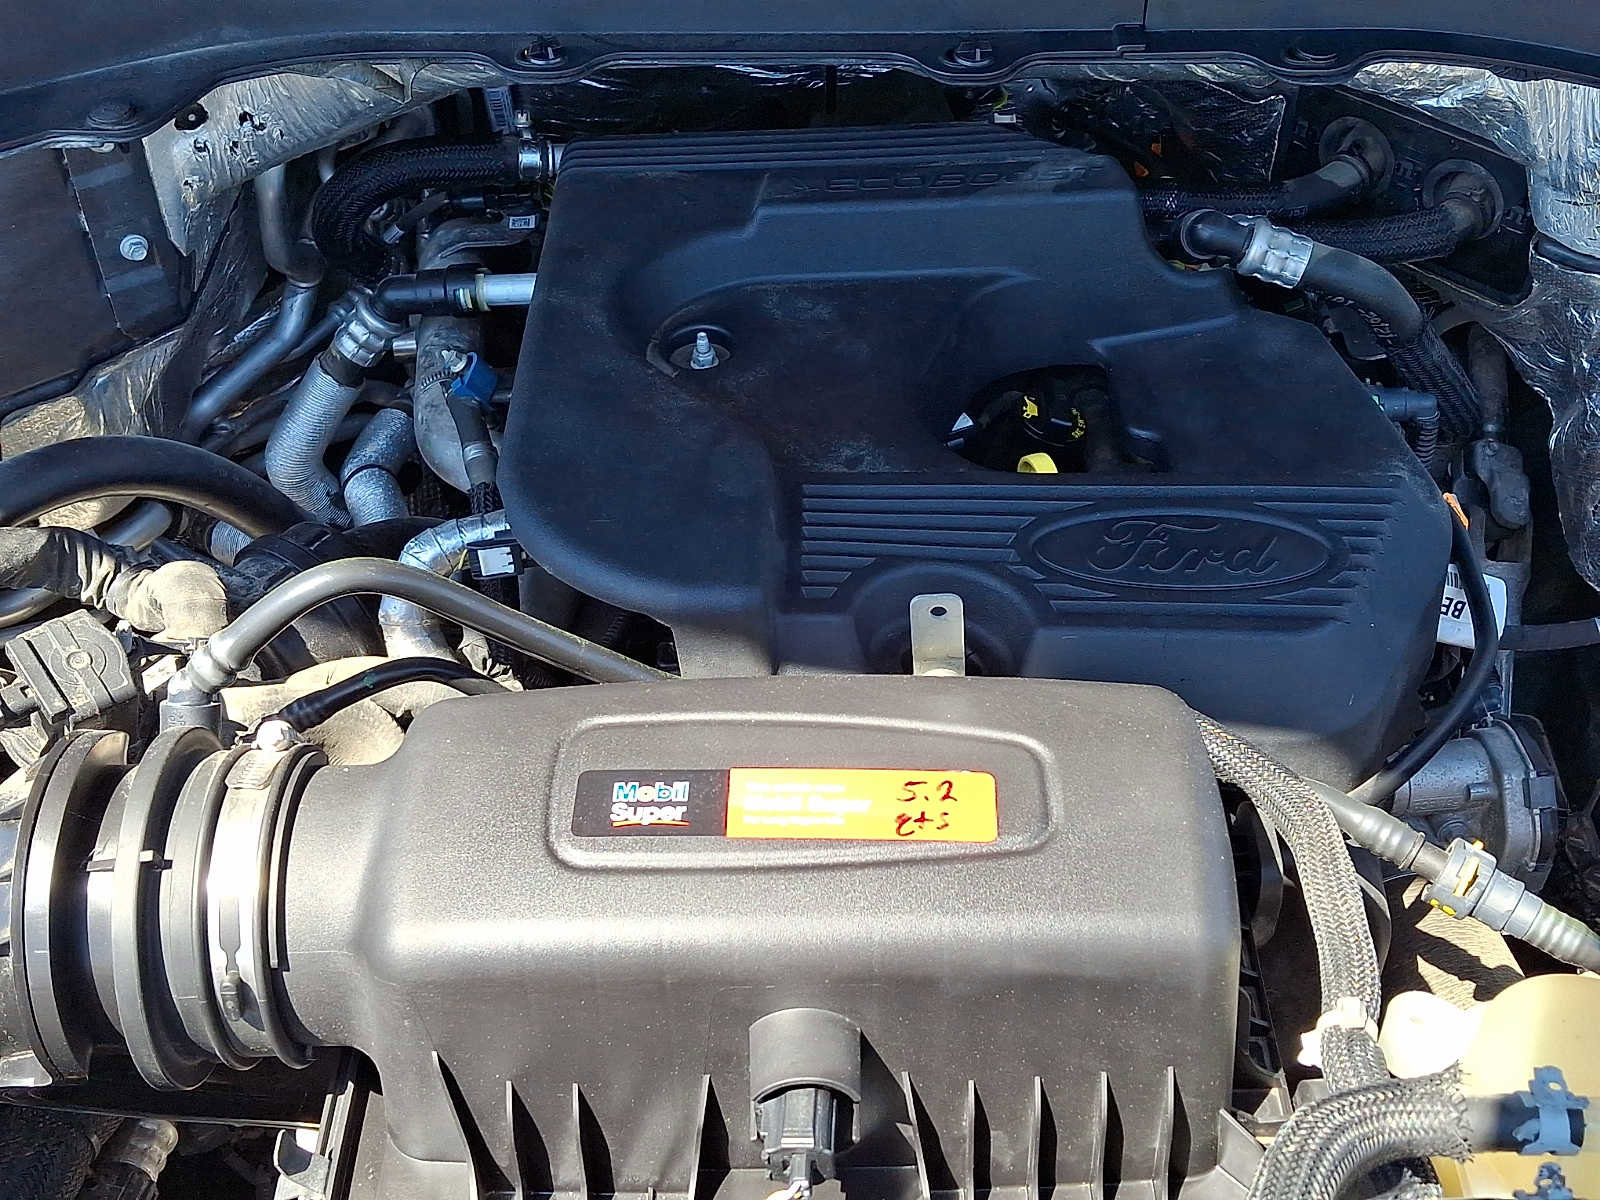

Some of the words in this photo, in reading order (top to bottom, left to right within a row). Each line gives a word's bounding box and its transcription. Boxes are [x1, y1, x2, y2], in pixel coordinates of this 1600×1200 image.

[1088, 519, 1279, 576] Ford
[612, 781, 690, 803] Mobil
[896, 780, 958, 802] 5.2
[610, 802, 688, 825] Super
